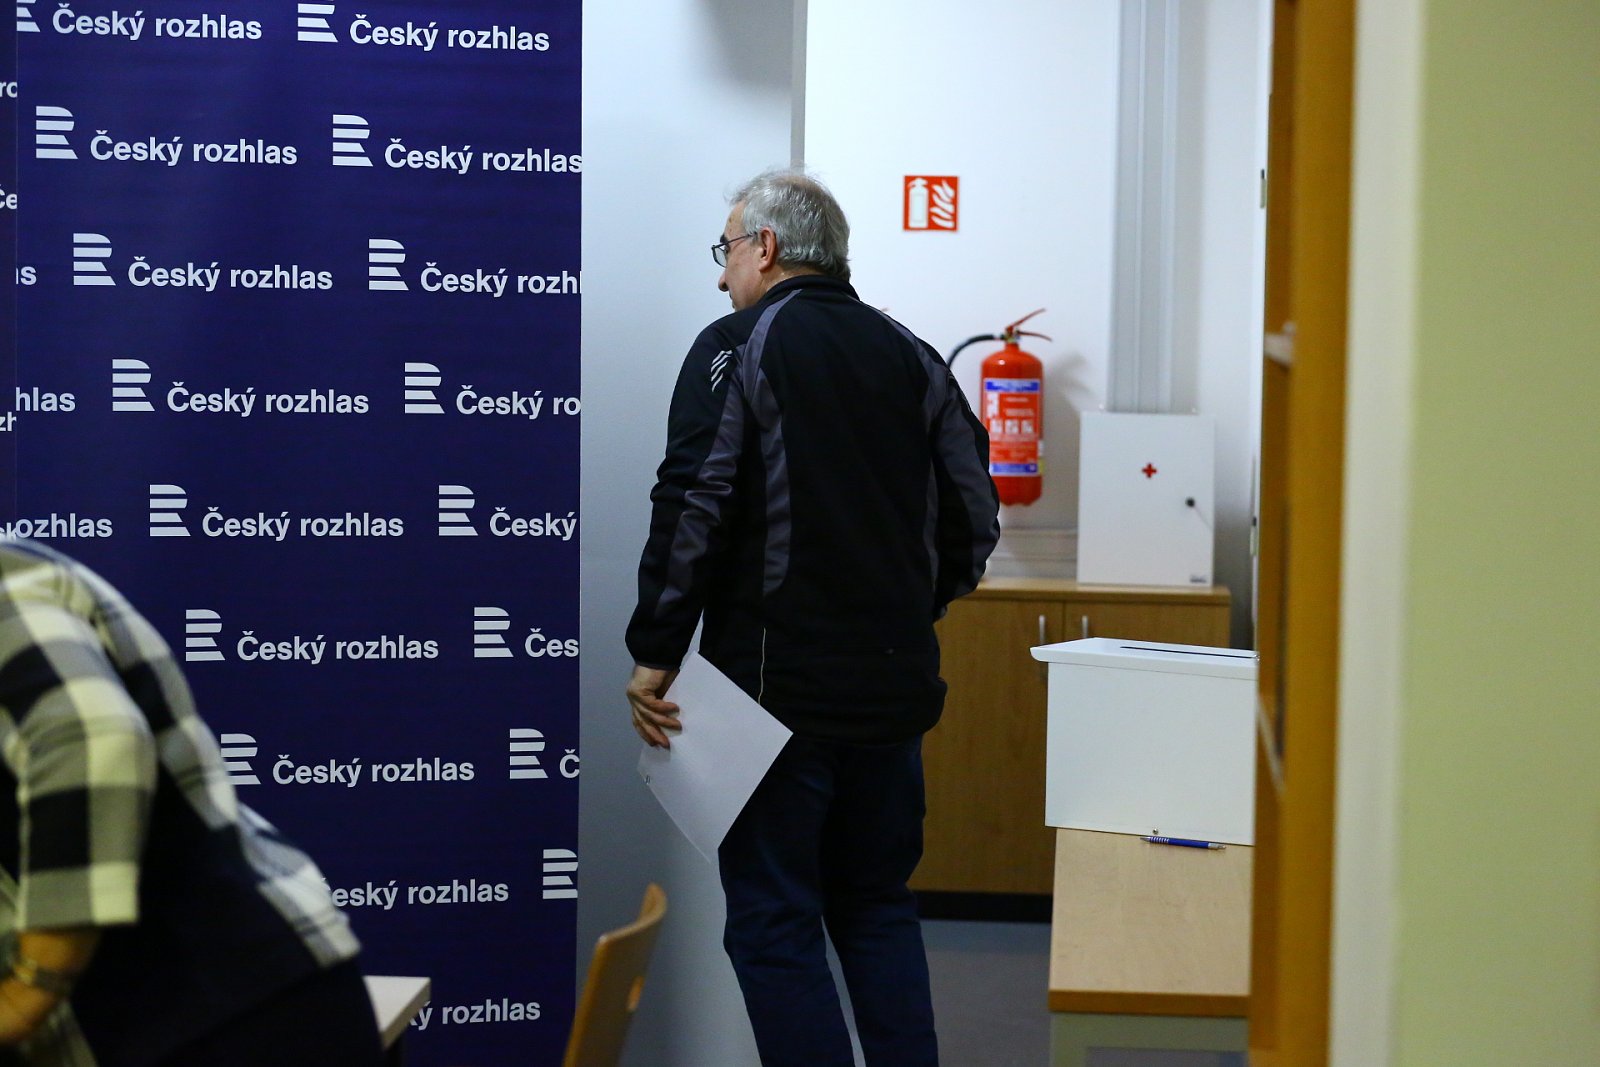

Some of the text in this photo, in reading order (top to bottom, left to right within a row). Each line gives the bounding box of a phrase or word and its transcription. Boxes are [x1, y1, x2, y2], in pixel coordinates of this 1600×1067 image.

[52, 2, 263, 41] Český rozhlas
[349, 13, 439, 52] Český
[447, 25, 550, 52] rozhlas
[90, 129, 184, 167] Český
[193, 138, 298, 165] rozhlas
[384, 137, 474, 175] Český
[482, 147, 582, 173] rozhlas
[127, 255, 221, 292] Český
[230, 264, 333, 290] rozhlas
[420, 261, 509, 298] Český
[517, 270, 582, 294] rozh
[166, 381, 257, 418] Český
[265, 388, 369, 414] rozhlas
[456, 384, 544, 420] Český
[202, 506, 291, 542] Český
[300, 512, 404, 537] rozhlas
[489, 506, 577, 541] Český
[237, 630, 327, 665] Český
[335, 634, 439, 660] rozhlas
[272, 754, 362, 788] Český
[371, 757, 475, 783] rozhlas
[322, 878, 509, 911] eský rozhlas
[442, 997, 541, 1025] rozhlas
